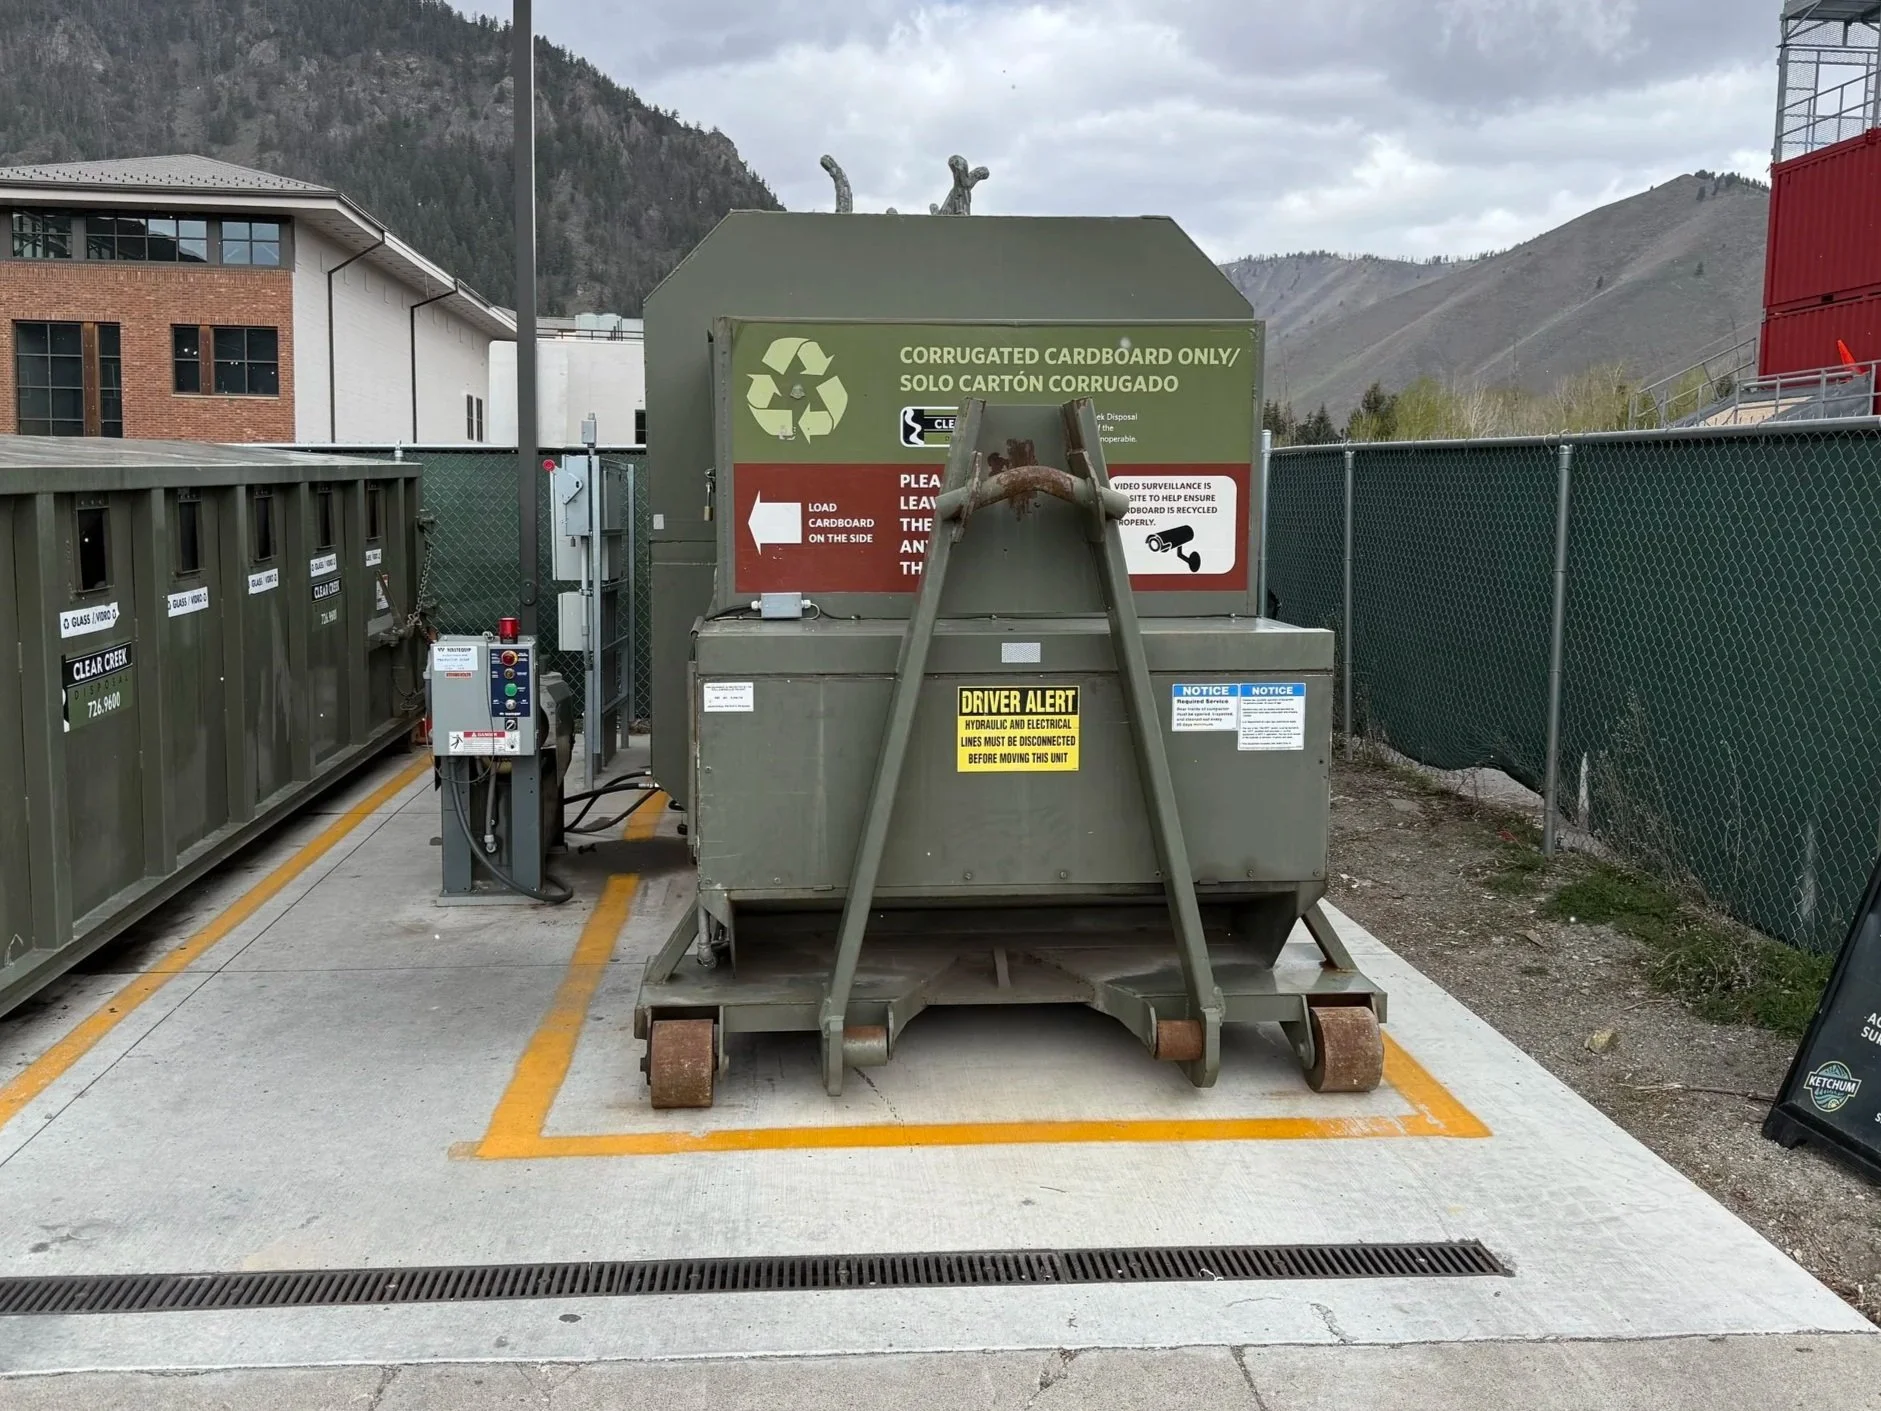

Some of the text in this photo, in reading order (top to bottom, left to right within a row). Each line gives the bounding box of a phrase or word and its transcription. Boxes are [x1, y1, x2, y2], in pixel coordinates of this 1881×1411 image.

[900, 346, 1241, 367] CORRUGATED CARDBOARD ONLY/
[900, 370, 1179, 392] SOLO CARTÓN CORRUGADO
[1106, 413, 1138, 422] Disposal
[934, 419, 955, 429] CLE
[1100, 435, 1137, 443] noperable.
[900, 474, 941, 488] PLEA
[1114, 482, 1140, 490] VIDEO
[1141, 482, 1202, 490] SURVEILLANCE
[900, 496, 936, 510] LEA
[1149, 494, 1160, 502] TO
[1161, 494, 1183, 502] HELP
[1183, 494, 1216, 502] ENSURE
[808, 503, 838, 512] LOAD
[1127, 506, 1218, 514] DBOARD IS RECYCLED
[808, 518, 875, 528] CARDBOARD
[1118, 518, 1156, 526] ROPERLY.
[808, 533, 873, 543] ON THE SIDE
[172, 597, 188, 609] GLASS
[71, 614, 91, 628] GLASS
[95, 609, 111, 622] VIDRO
[73, 647, 128, 681] CLEAR CREEK
[74, 674, 129, 701] DISPOSAL
[1182, 686, 1230, 696] NOTICE
[1251, 686, 1294, 695] NOTICE
[87, 691, 121, 718] 726.9600
[962, 690, 1076, 714] DRIVER ALERT
[965, 718, 1072, 730] HYDRAULIC AND ELECTRICAL
[960, 735, 1076, 748] LINES MUST BE DISCONNECTED
[968, 752, 1069, 764] BEFORE MOVING THIS UNIT
[1808, 1075, 1857, 1093] KETCHUM
